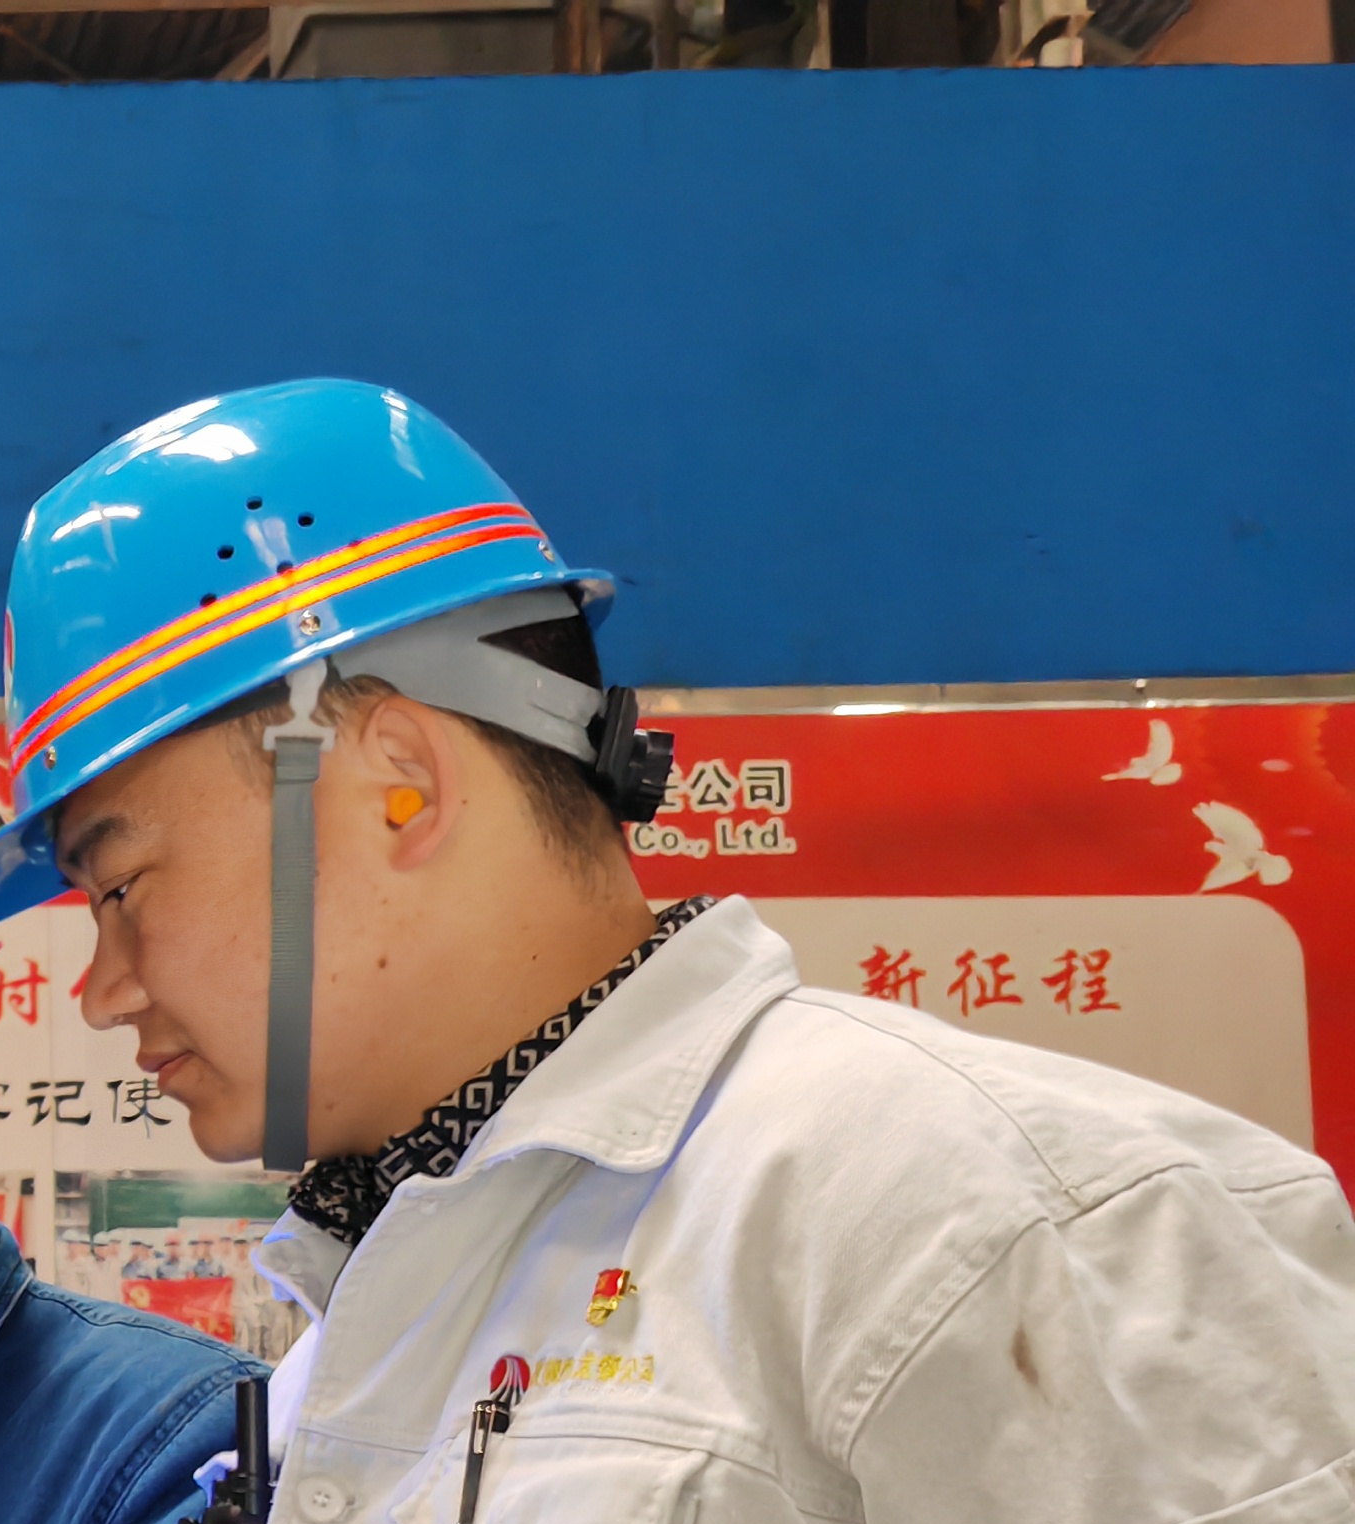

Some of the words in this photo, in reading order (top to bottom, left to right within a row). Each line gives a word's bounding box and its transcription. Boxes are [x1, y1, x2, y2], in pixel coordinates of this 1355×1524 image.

[634, 824, 704, 853] Co.,
[721, 823, 792, 850] Ltd.
[858, 944, 1122, 1017] 新征程
